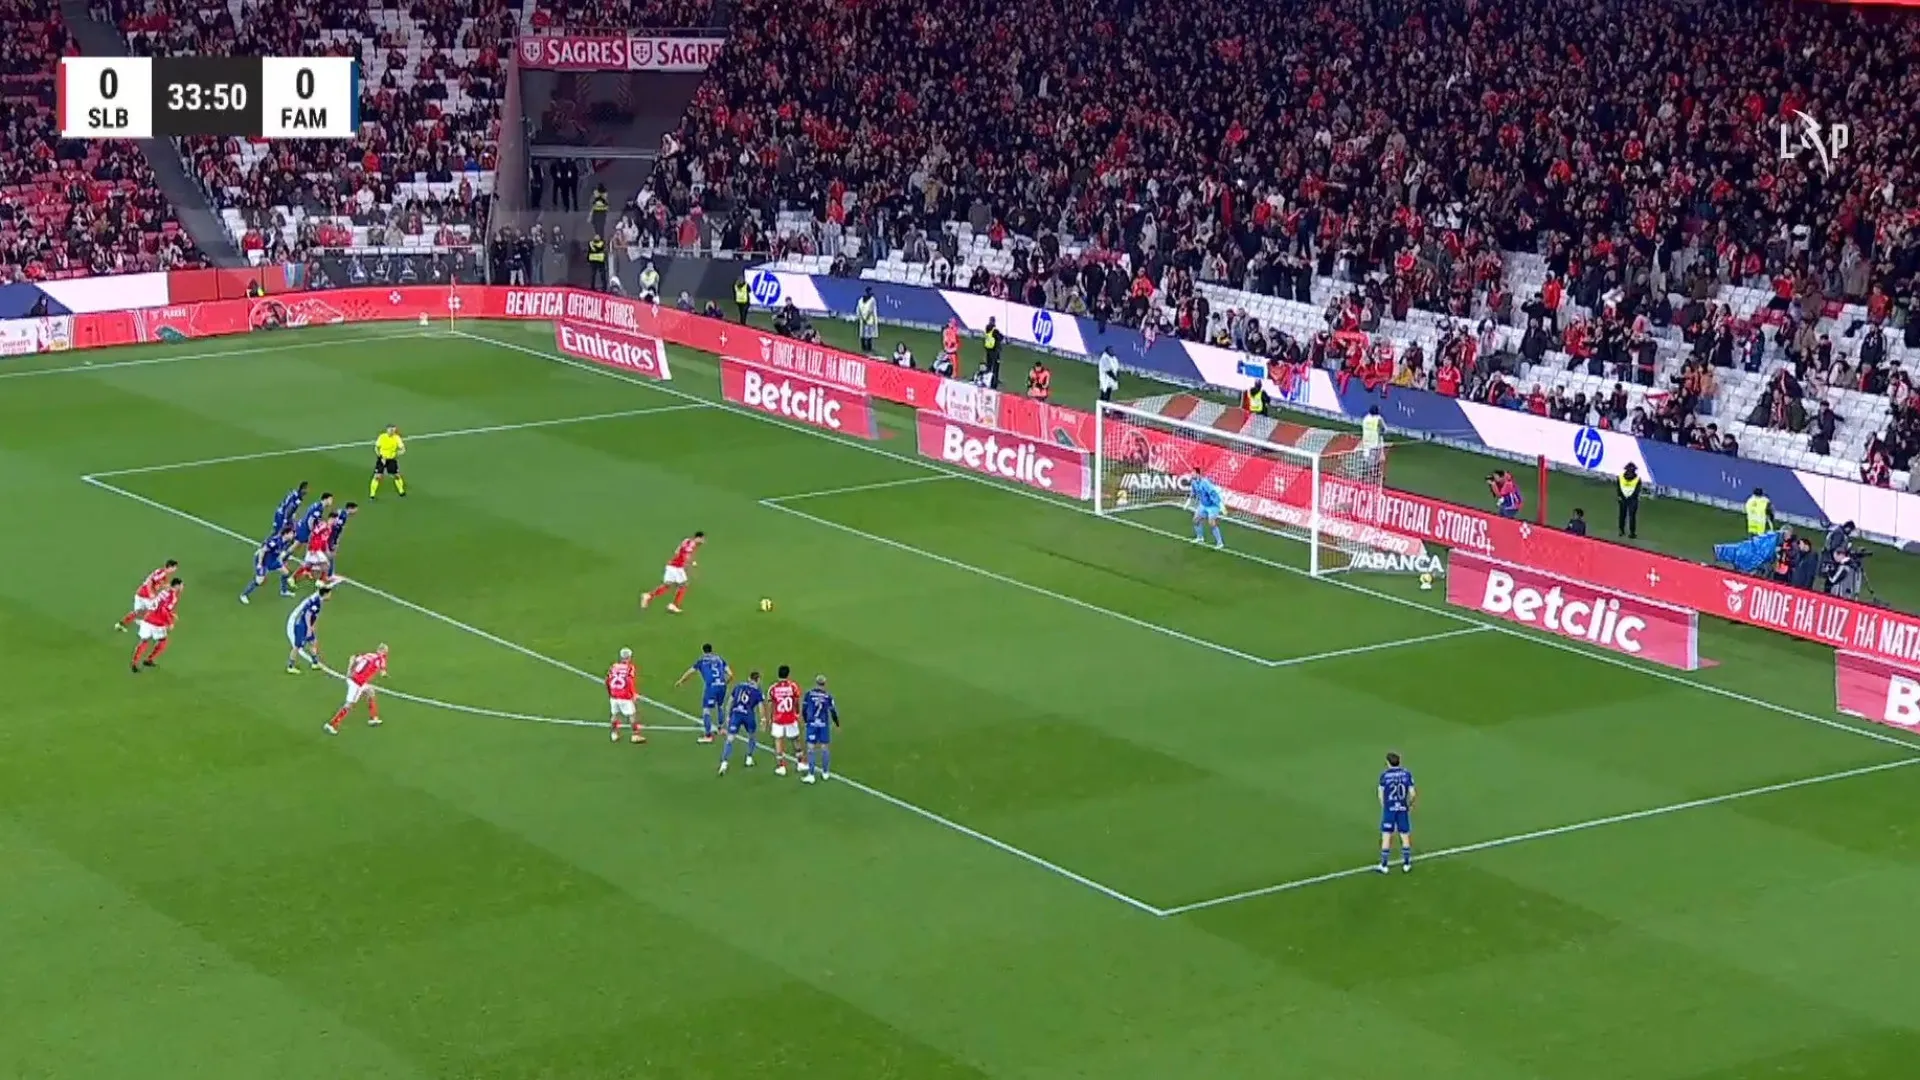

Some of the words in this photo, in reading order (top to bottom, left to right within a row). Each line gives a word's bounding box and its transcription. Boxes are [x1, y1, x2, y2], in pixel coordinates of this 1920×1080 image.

[547, 39, 625, 65] SAGRES
[657, 40, 720, 65] SAGRE
[505, 291, 563, 317] BENFICA
[567, 292, 604, 322] OFFICIAL
[754, 270, 780, 306] hp
[1033, 308, 1053, 346] hp
[561, 326, 654, 371] Emirates
[744, 370, 841, 429] Betclic
[942, 424, 1054, 488] Betclic
[1576, 426, 1603, 470] hp
[1377, 493, 1432, 536] OFFICIAL
[1482, 569, 1646, 653] Betclic
[1749, 586, 1793, 627] ONDE
[1792, 597, 1816, 634] HÁ
[1816, 602, 1850, 644] LUZ,
[1853, 612, 1879, 650] HÁ
[776, 696, 794, 713] 20
[1388, 783, 1406, 801] 20
